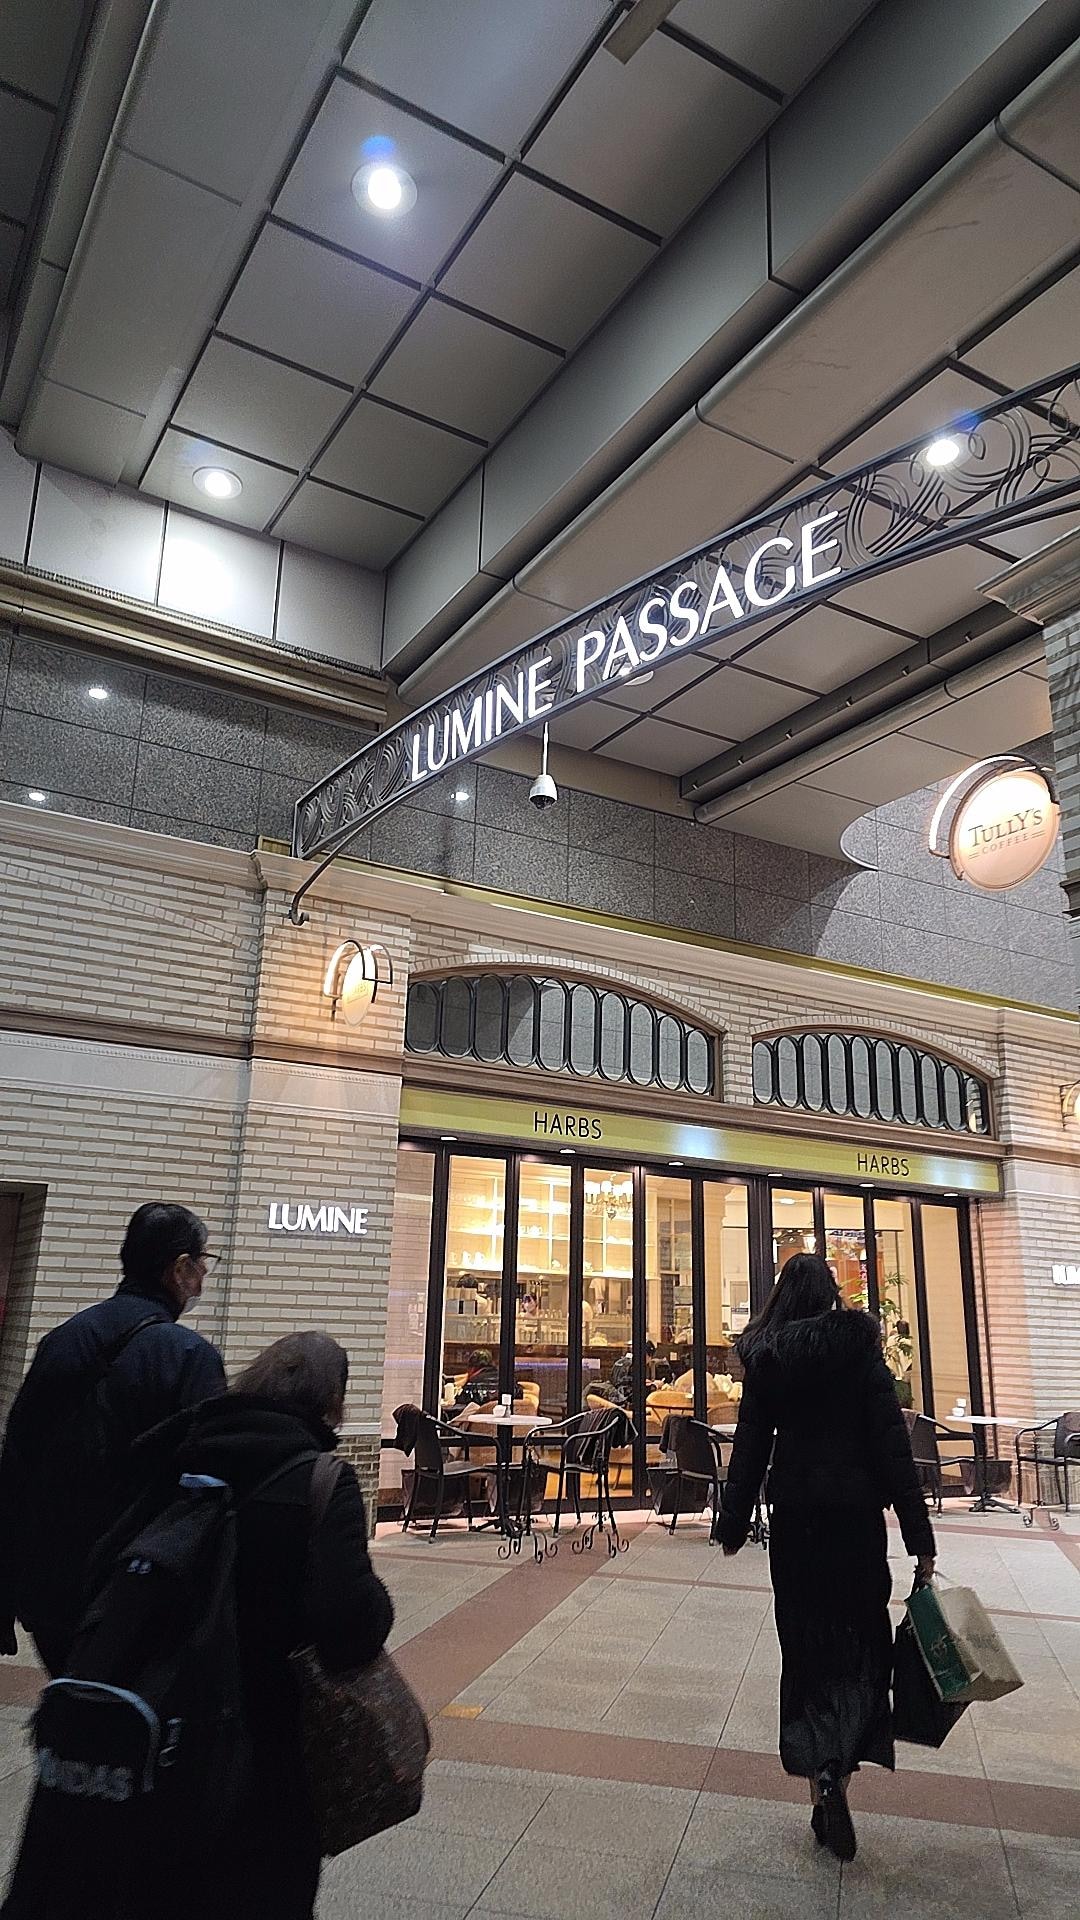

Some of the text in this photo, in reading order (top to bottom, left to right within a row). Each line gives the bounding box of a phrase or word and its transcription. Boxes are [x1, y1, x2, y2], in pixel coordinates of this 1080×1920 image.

[411, 510, 842, 782] LUMINE PASSAGE
[968, 808, 1043, 847] TULLY'S
[982, 833, 1028, 855] COFFEE
[534, 1111, 602, 1140] HARBS
[857, 1153, 910, 1176] HARBS
[268, 1203, 369, 1235] LUMINE
